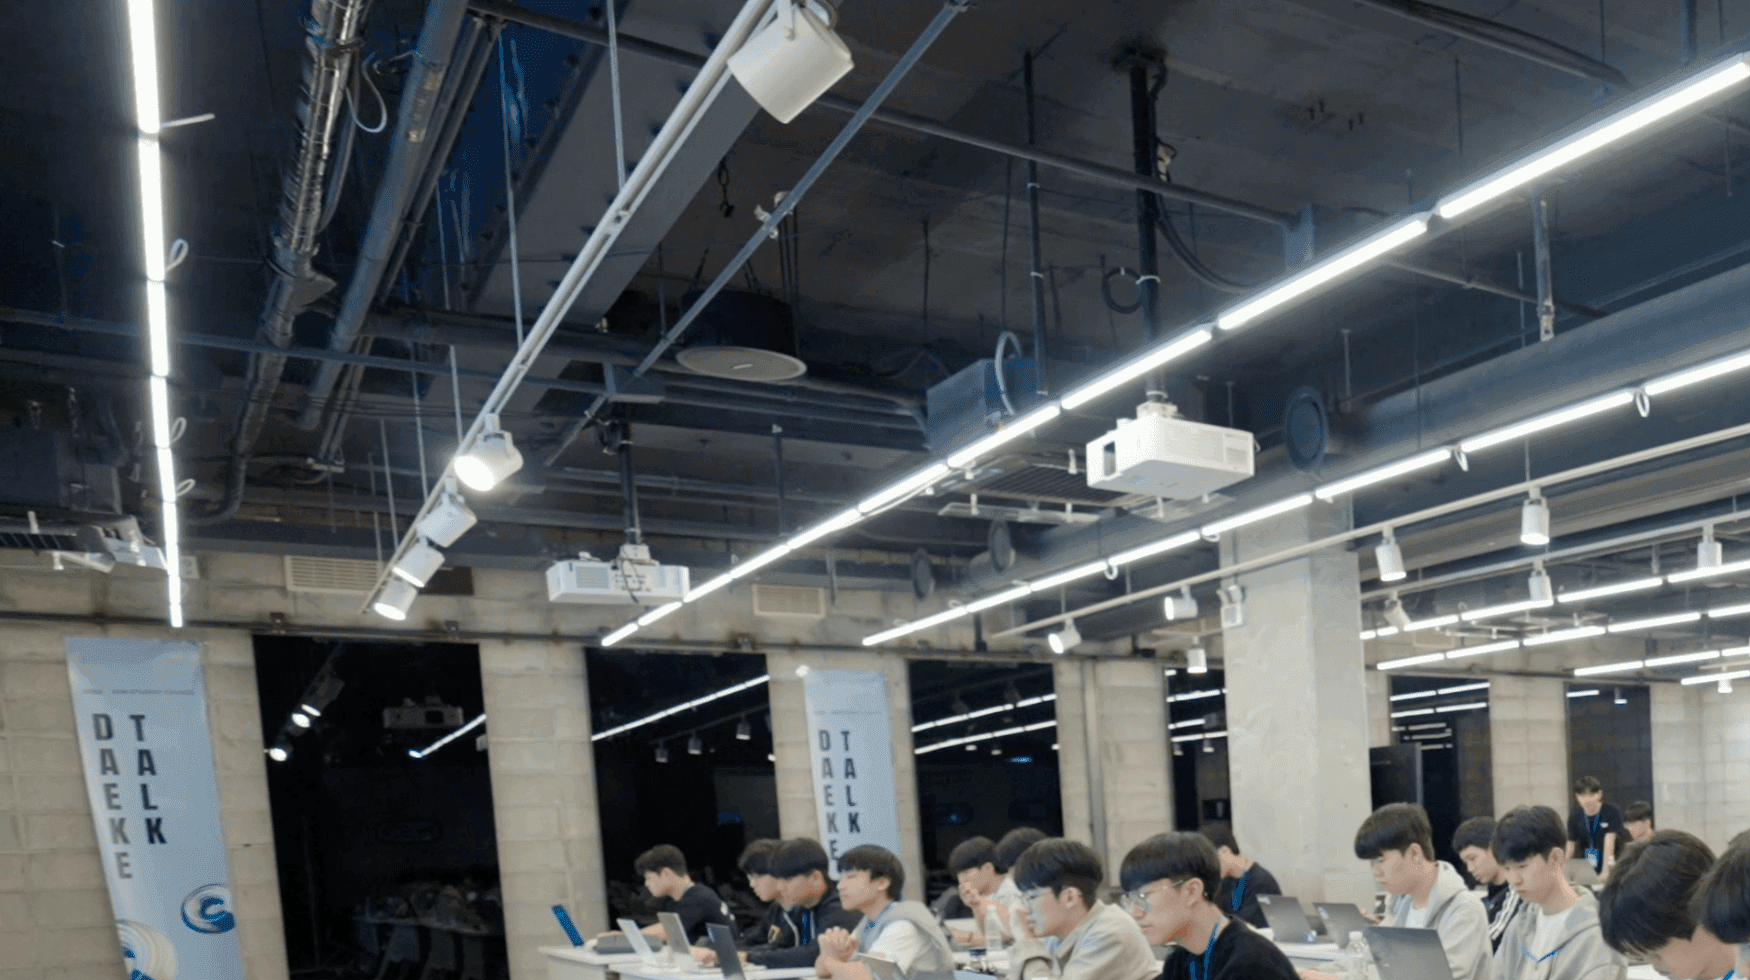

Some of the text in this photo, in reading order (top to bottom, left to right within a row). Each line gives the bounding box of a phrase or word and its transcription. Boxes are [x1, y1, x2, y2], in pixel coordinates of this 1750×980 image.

[92, 713, 133, 879] DAEKE
[129, 714, 167, 844] TALK
[819, 730, 839, 860] DAEKE
[841, 731, 860, 833] TALK
